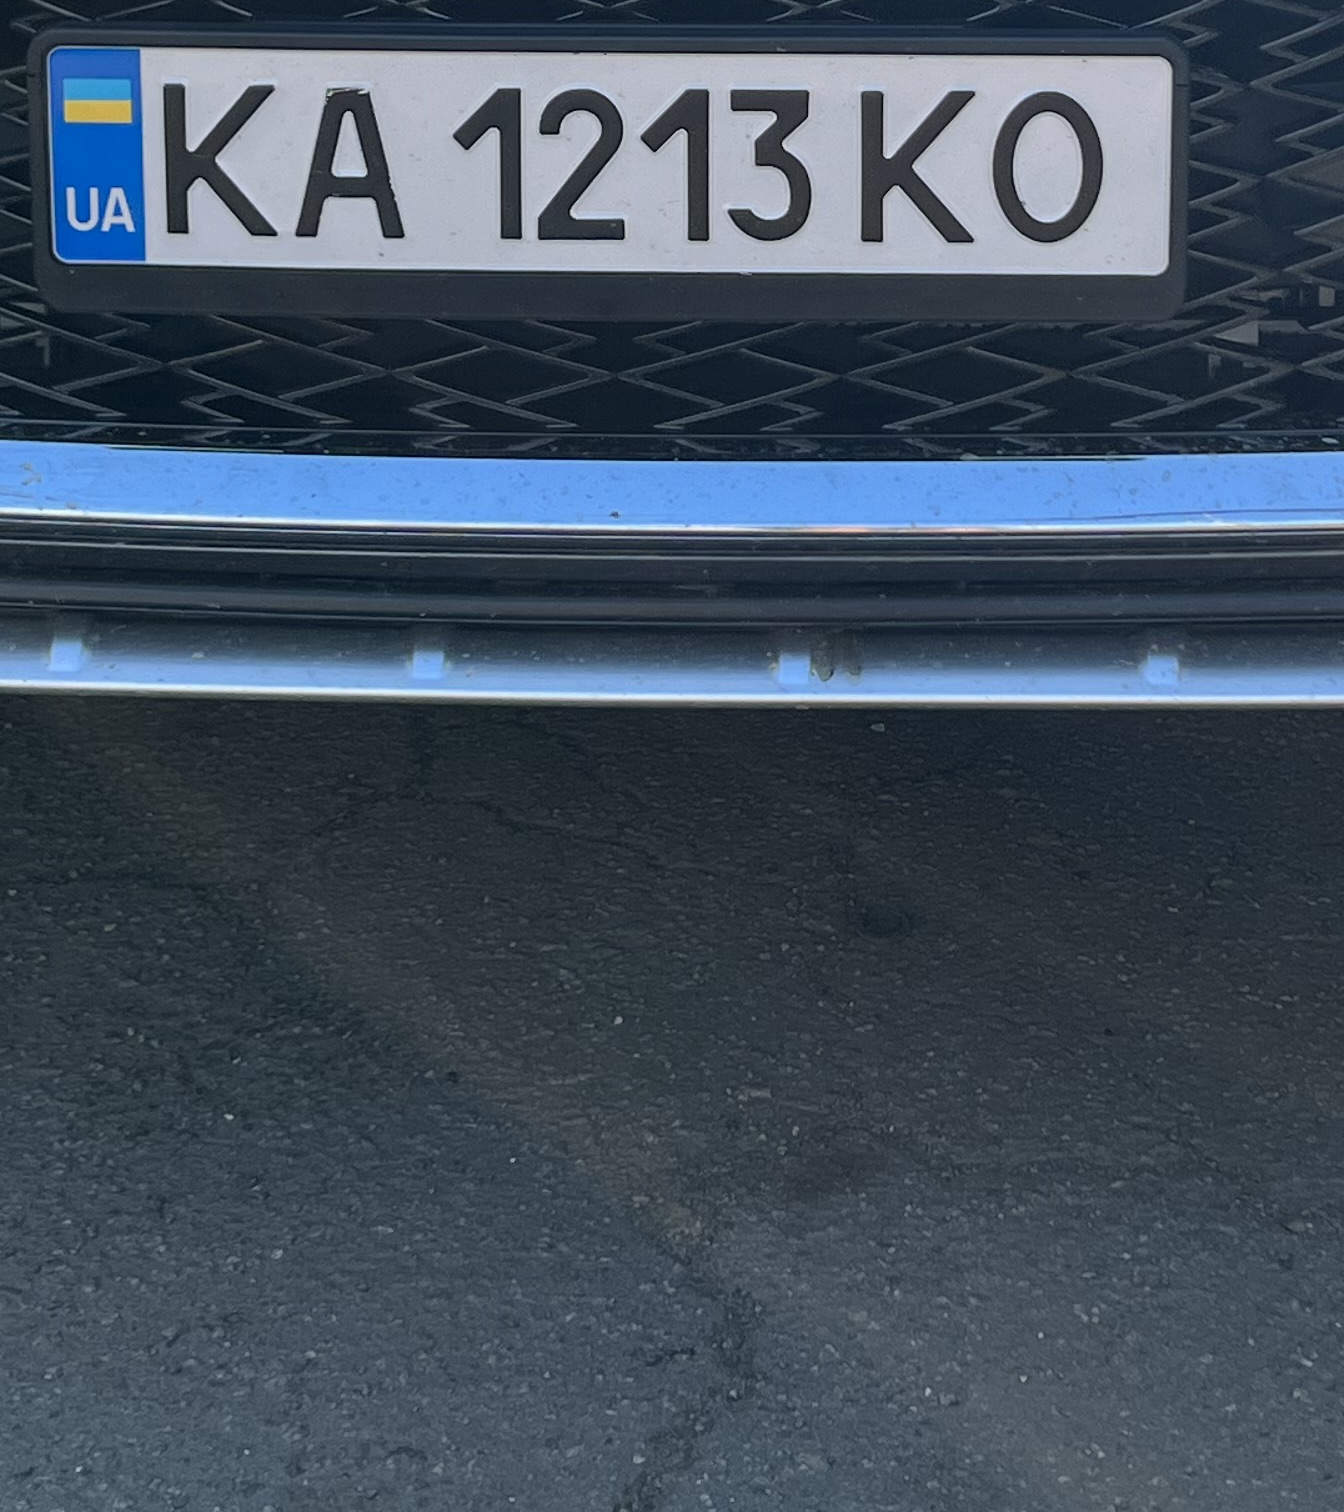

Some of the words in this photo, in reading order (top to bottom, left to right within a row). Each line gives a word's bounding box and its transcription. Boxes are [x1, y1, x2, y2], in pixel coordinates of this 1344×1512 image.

[65, 186, 136, 233] UA
[163, 83, 406, 238] KA
[452, 88, 813, 242] 1213
[860, 90, 1105, 244] KO
